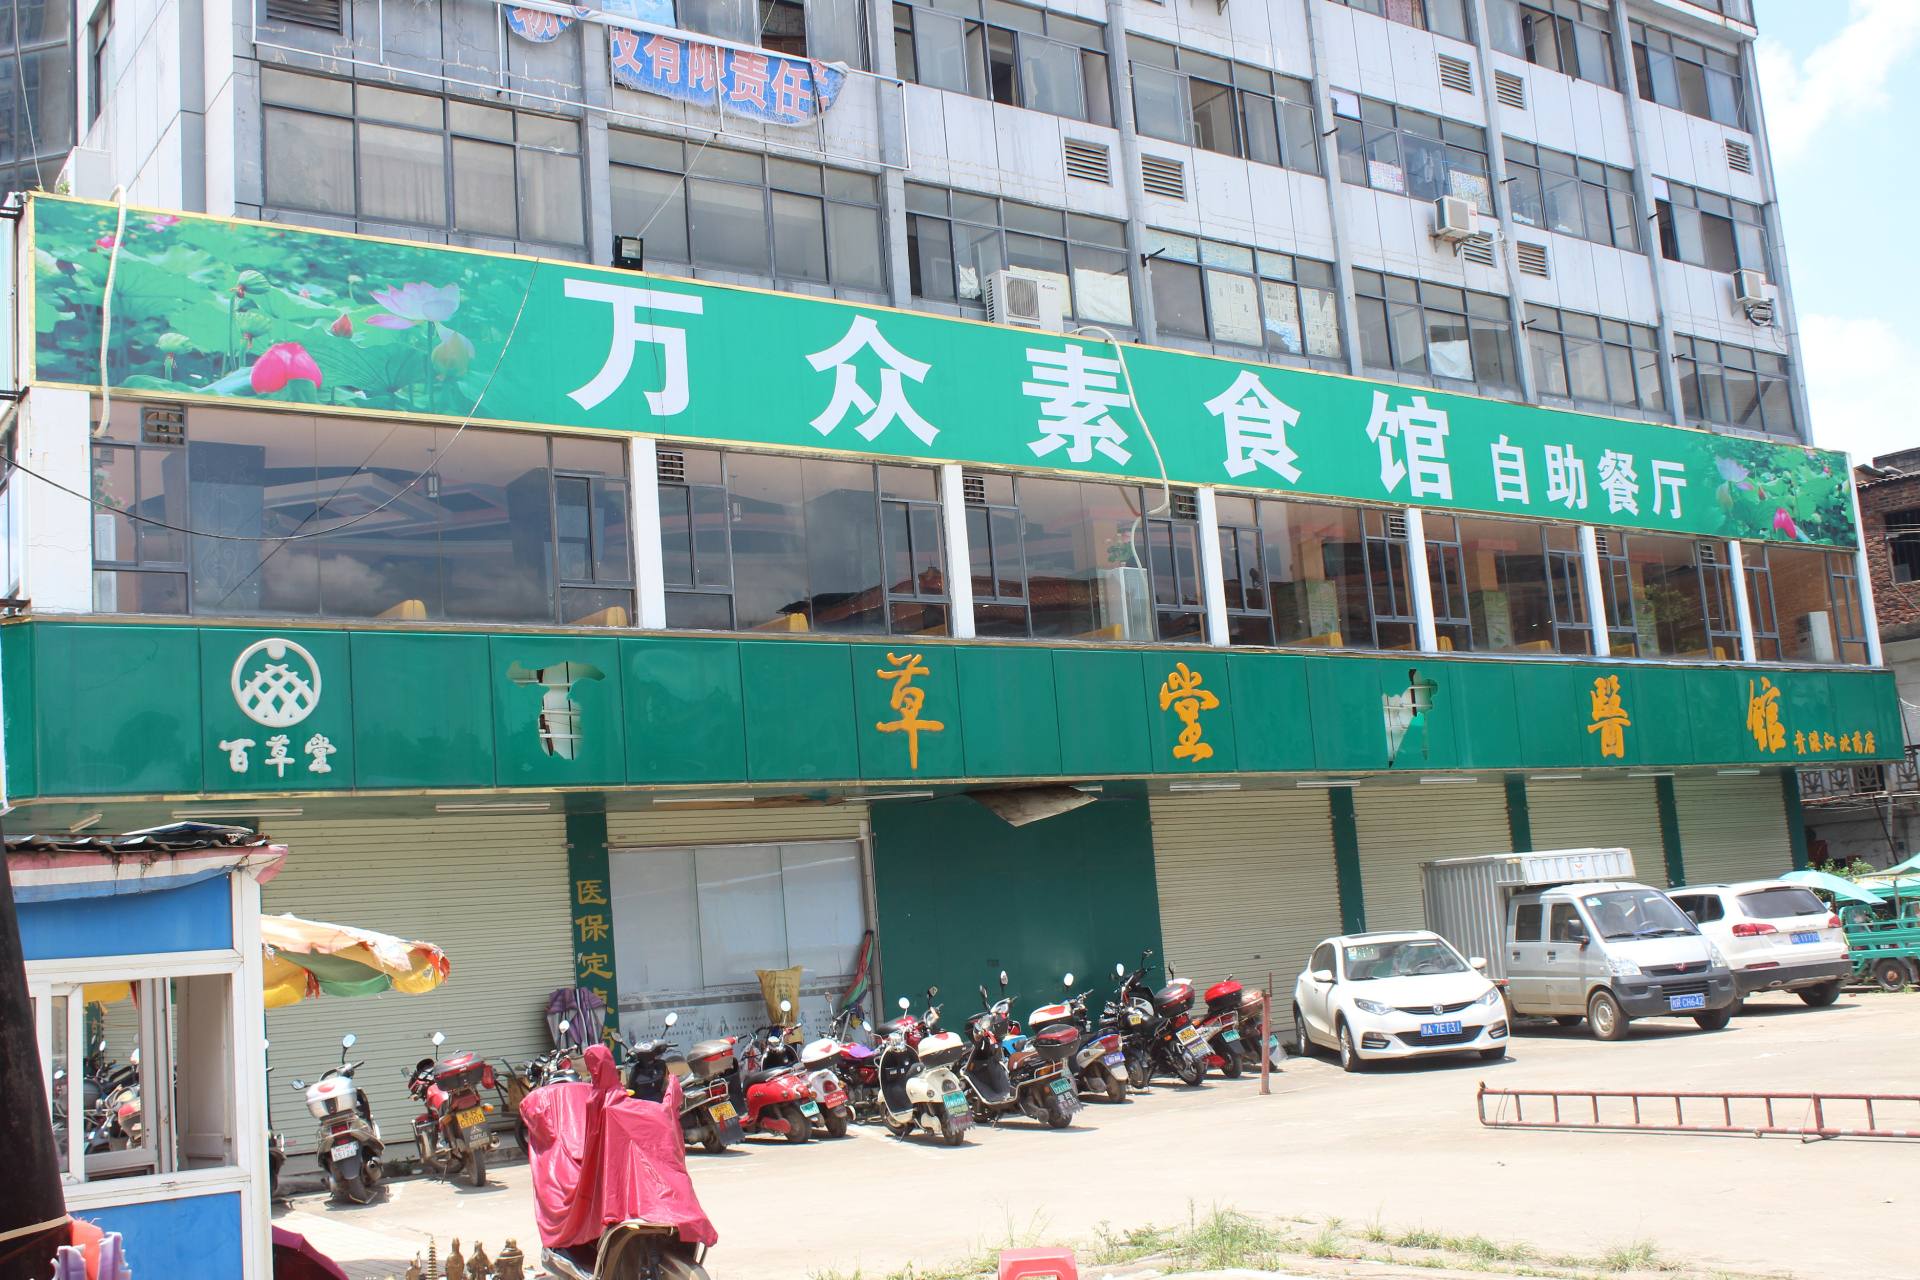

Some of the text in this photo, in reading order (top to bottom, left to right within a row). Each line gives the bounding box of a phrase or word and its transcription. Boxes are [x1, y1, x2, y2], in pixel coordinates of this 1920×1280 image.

[563, 277, 1453, 501] 万众素食馆
[1491, 434, 1688, 519] 自助餐厅
[219, 733, 338, 778] 百草堂
[575, 879, 617, 1050] 医保定
